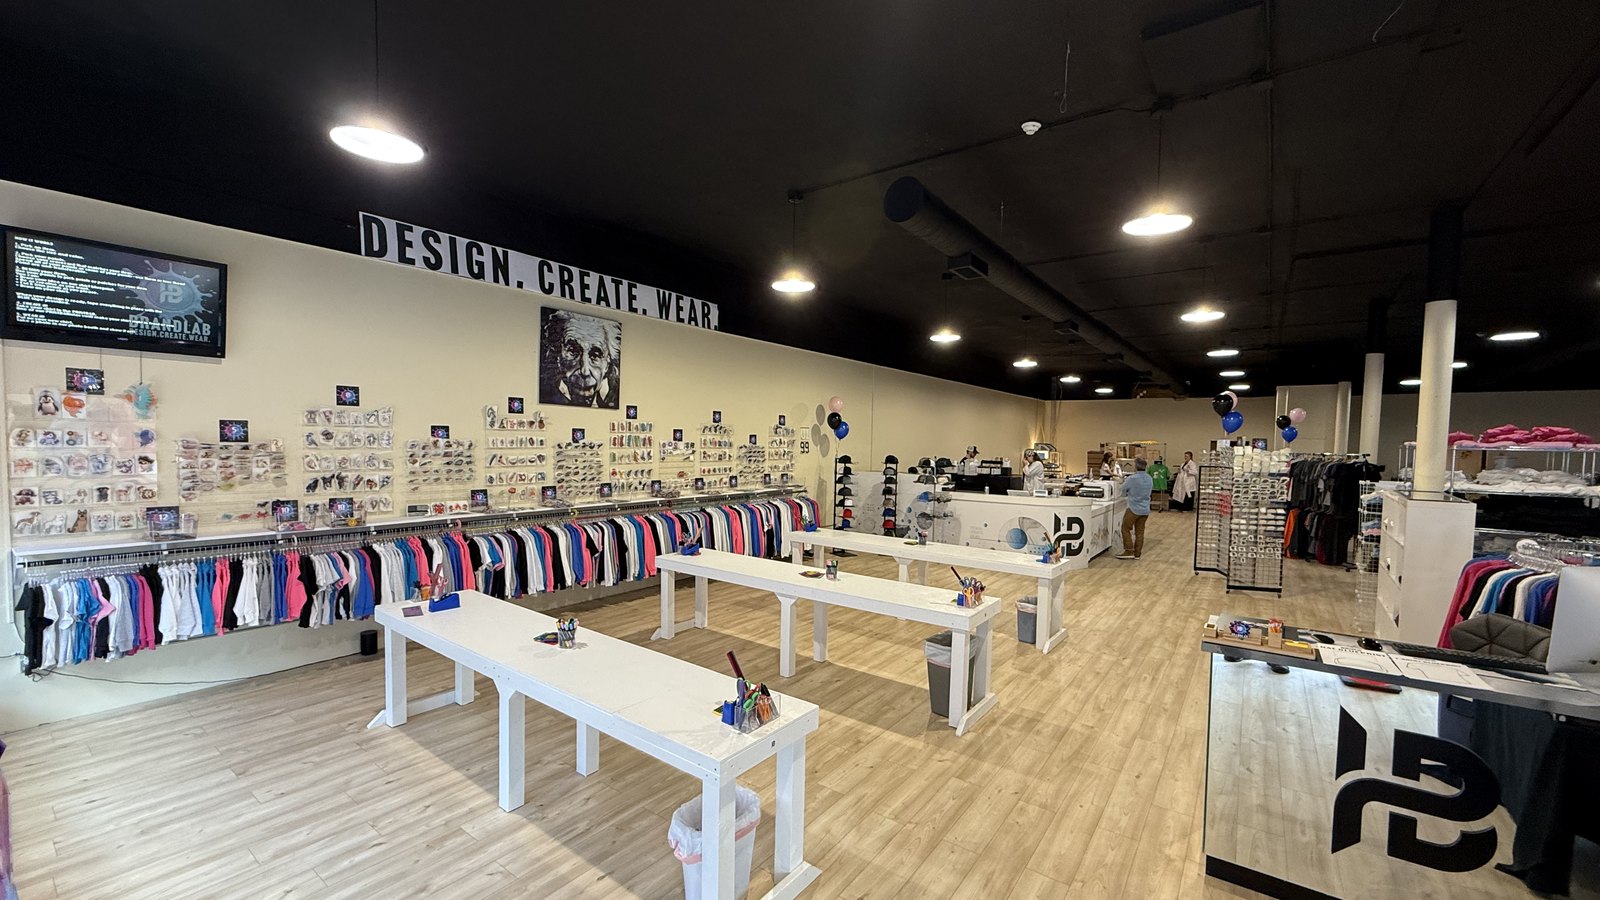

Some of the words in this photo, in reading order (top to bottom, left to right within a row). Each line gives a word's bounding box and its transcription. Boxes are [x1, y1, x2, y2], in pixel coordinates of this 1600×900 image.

[362, 213, 524, 289] DESIGN.
[537, 259, 648, 316] CREATE.
[655, 288, 718, 331] WEAR.
[129, 314, 211, 336] BRANDLAB
[799, 441, 810, 454] 99
